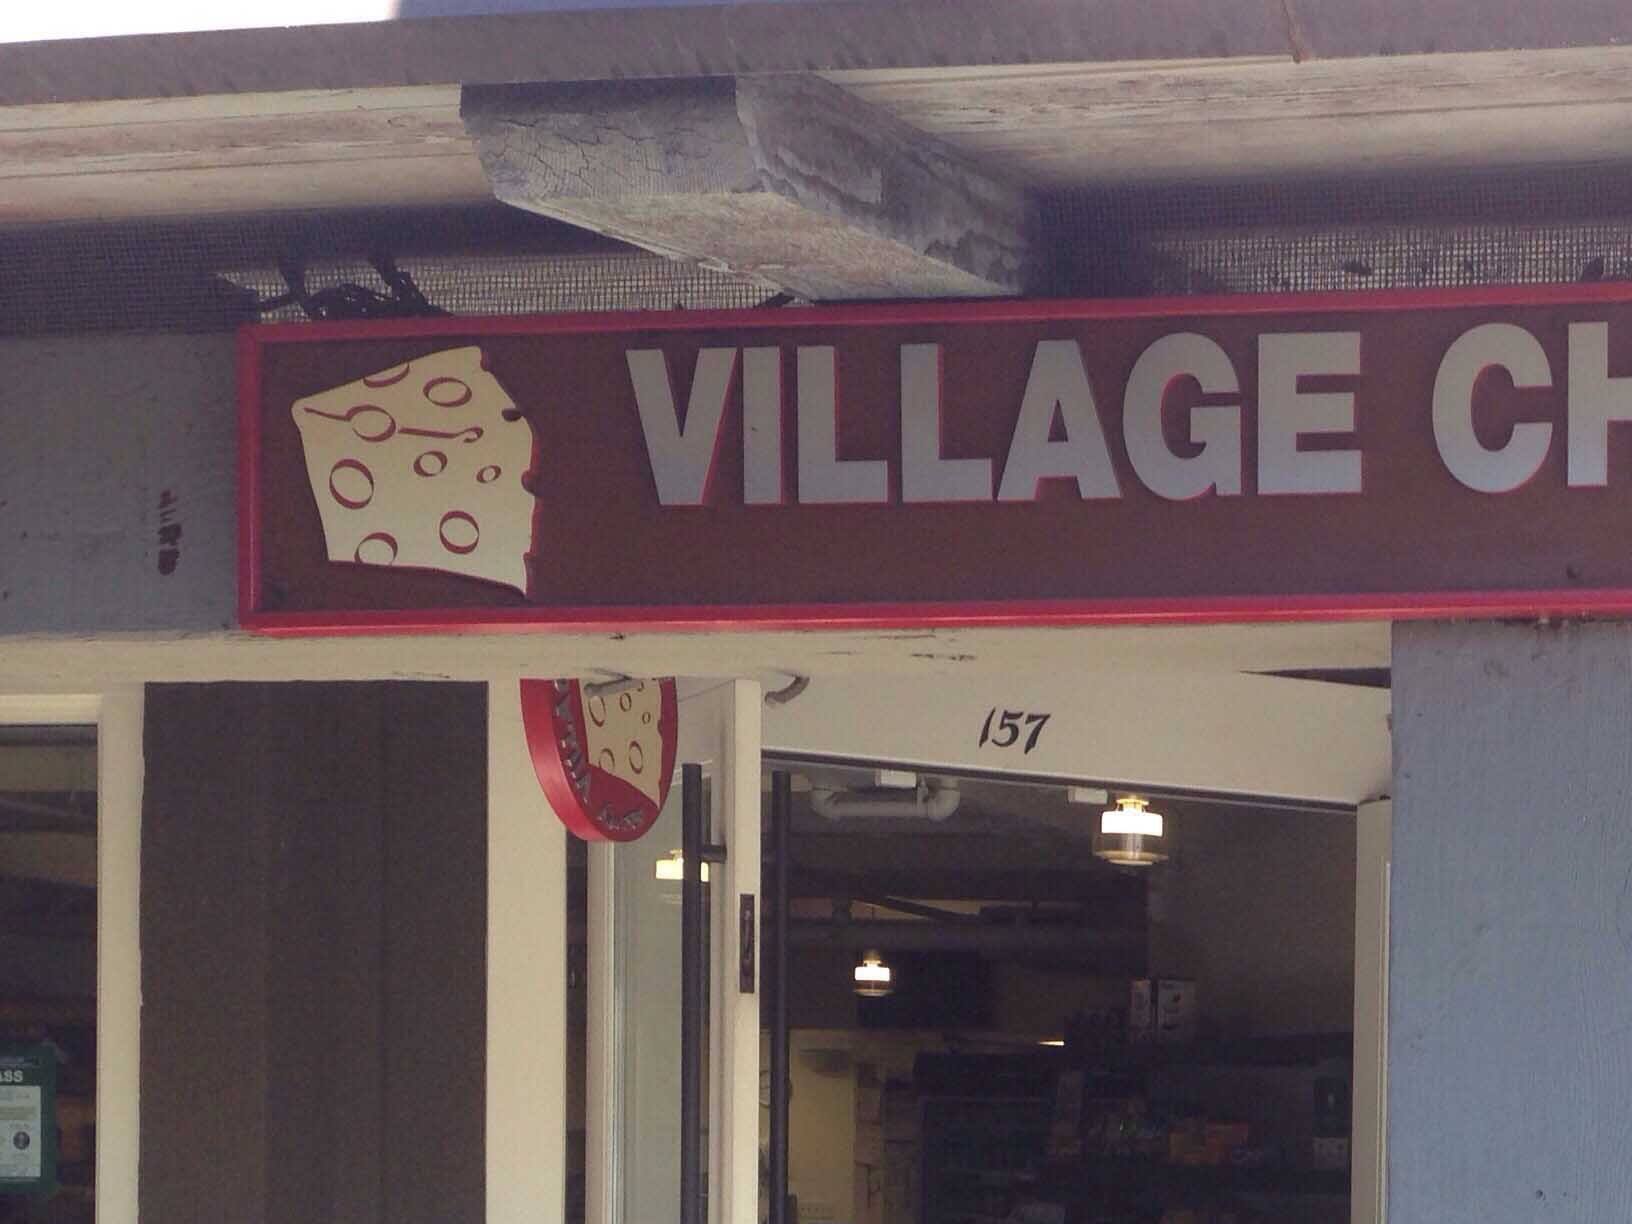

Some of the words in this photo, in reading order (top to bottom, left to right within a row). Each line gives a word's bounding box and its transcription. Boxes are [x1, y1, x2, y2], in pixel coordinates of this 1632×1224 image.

[626, 331, 1362, 506] VILLAGE
[979, 707, 1052, 755] 157
[0, 1069, 24, 1082] SS
